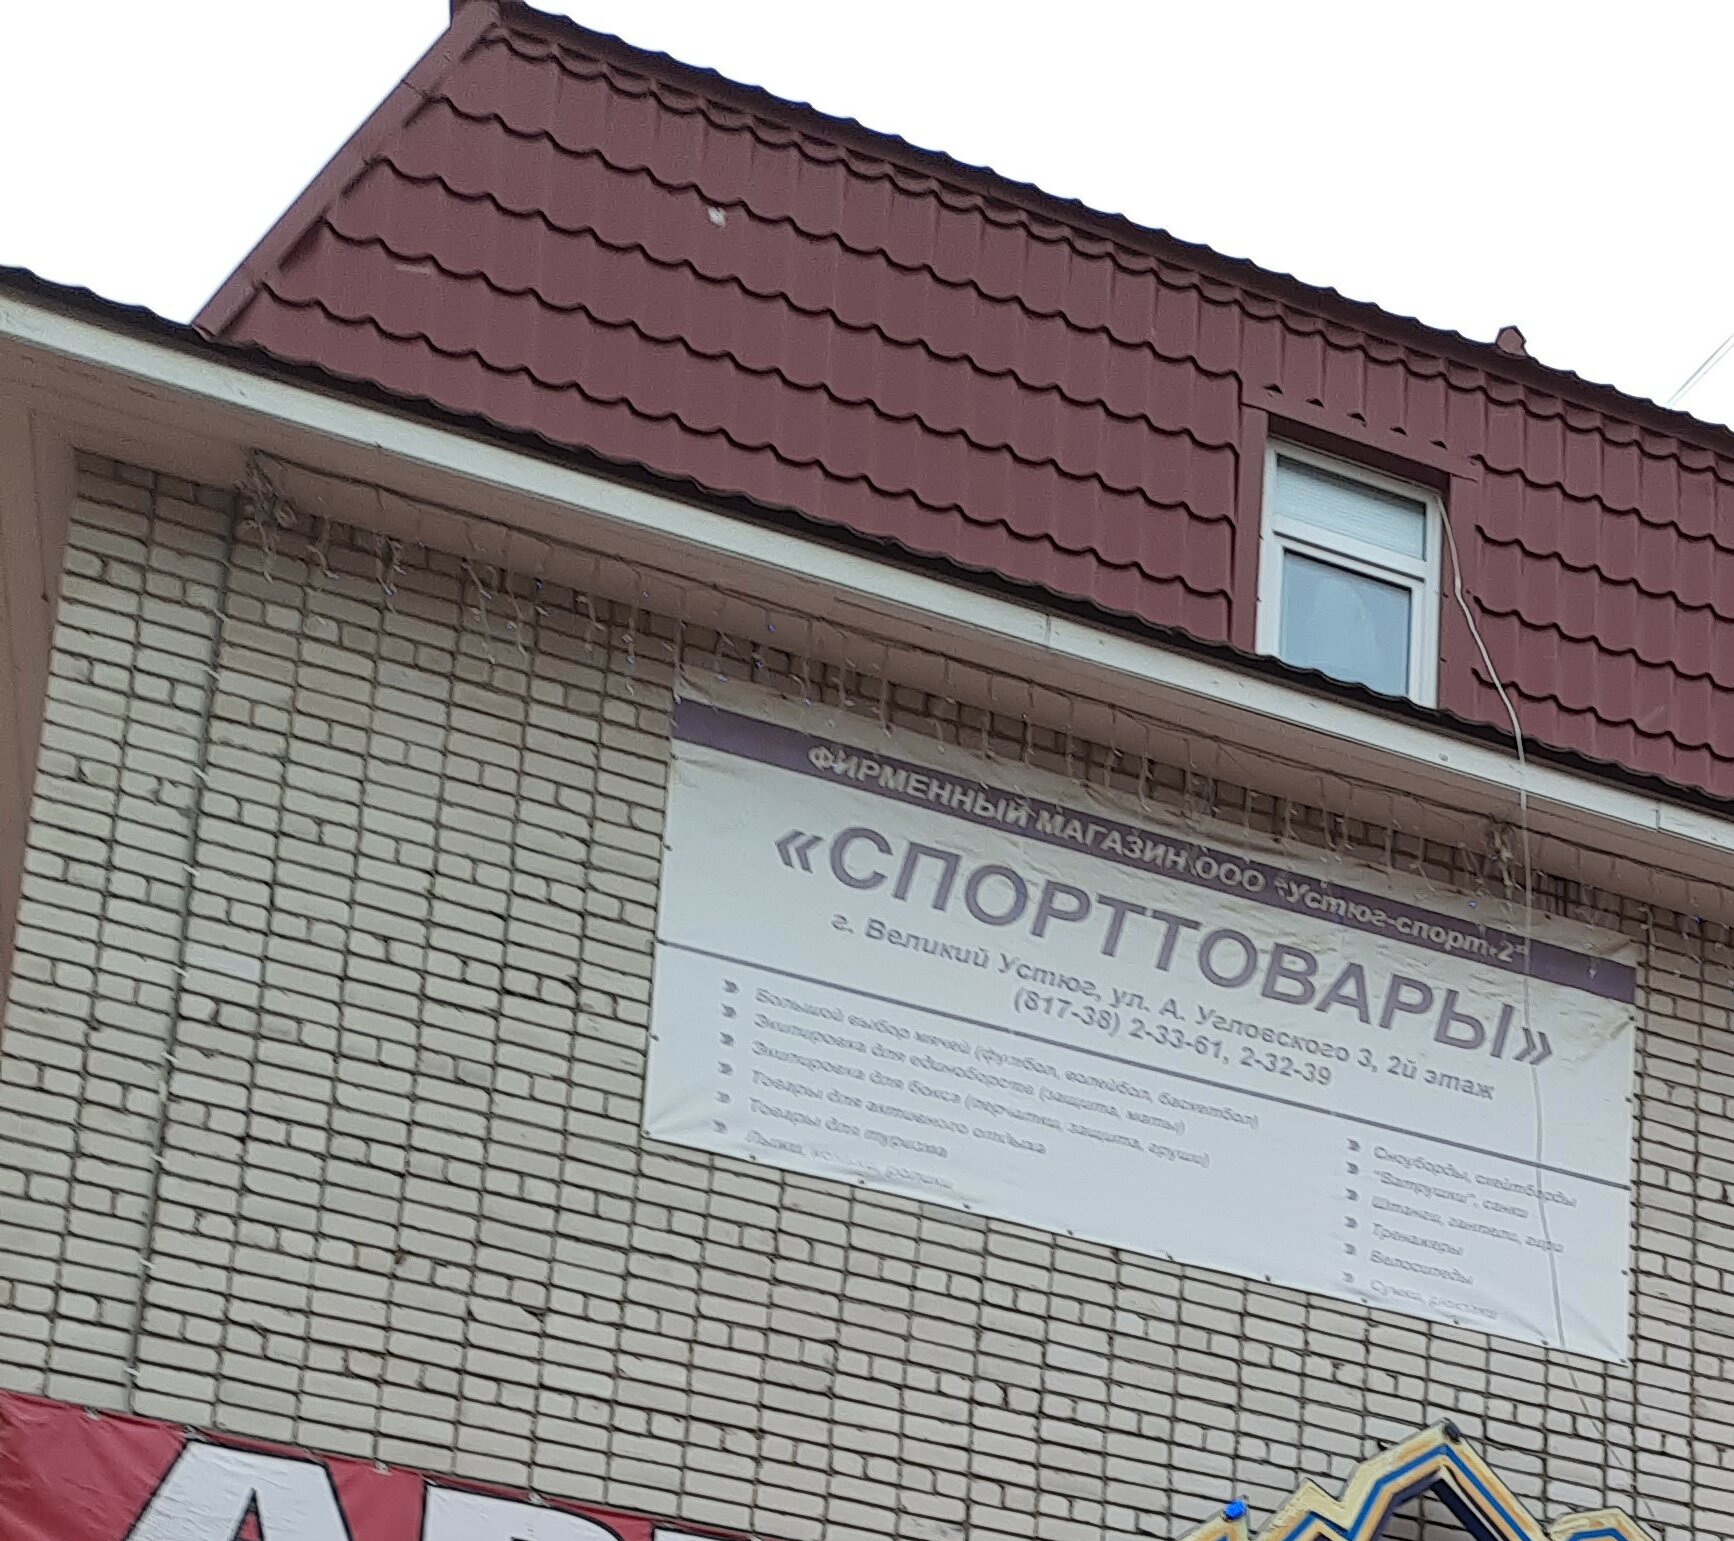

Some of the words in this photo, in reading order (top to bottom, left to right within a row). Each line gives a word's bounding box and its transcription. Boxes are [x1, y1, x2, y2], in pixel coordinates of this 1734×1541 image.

[806, 741, 1032, 828] ФИРМЕННЫЙ
[1035, 807, 1188, 872] МАГАЗИН
[1194, 853, 1266, 894] ООО
[774, 826, 1553, 1066] «СПОРТТОВАРЫ»
[754, 987, 844, 1024] Большой
[830, 913, 854, 934] г.
[864, 917, 989, 968] Великий
[998, 952, 1101, 1002] Устюг,
[1107, 987, 1151, 1012] ул.
[1157, 997, 1186, 1022] А.
[1195, 1005, 1350, 1061] Угловского
[1356, 1047, 1378, 1073] 3,
[1386, 1054, 1417, 1080] 2й
[1423, 1068, 1494, 1100] этаж
[869, 1039, 906, 1064] для
[1013, 987, 1120, 1037] (817-38)
[1128, 1017, 1228, 1064] 2-33-61,
[1239, 1045, 1331, 1085] 2-32-39
[825, 1085, 864, 1109] для
[867, 1067, 905, 1091] для
[823, 1114, 861, 1139] для
